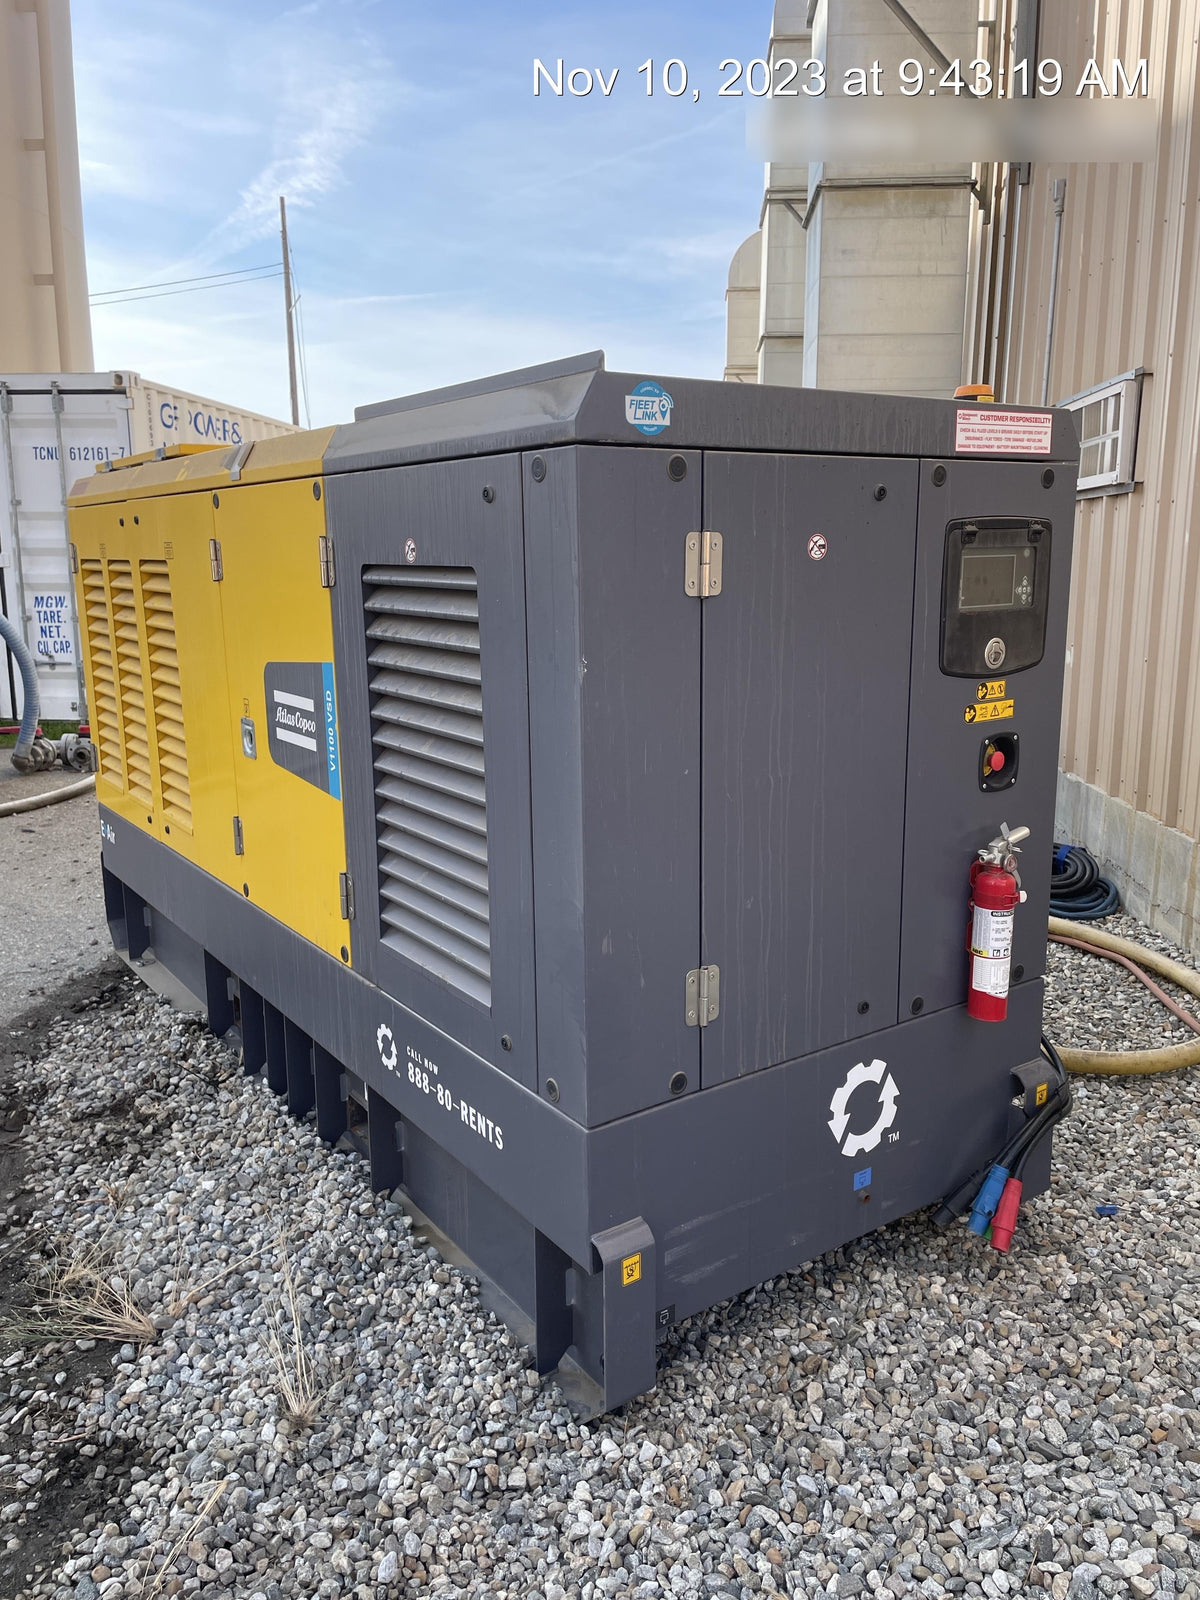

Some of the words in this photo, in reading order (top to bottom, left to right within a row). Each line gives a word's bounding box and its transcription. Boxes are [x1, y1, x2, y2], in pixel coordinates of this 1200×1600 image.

[980, 414, 1008, 422] CUSTOMER
[1009, 416, 1051, 424] RESPONSIBILITY
[69, 447, 125, 461] 612161-7
[33, 596, 68, 608] MGW.
[36, 610, 66, 624] TARE.
[40, 626, 66, 638] NET.
[53, 641, 72, 654] CAP.
[328, 728, 336, 771] V1100
[406, 1045, 422, 1064] CALL
[424, 1057, 439, 1075] NOW
[407, 1061, 504, 1150] 888-80-RENTS
[888, 1132, 900, 1143] TM
